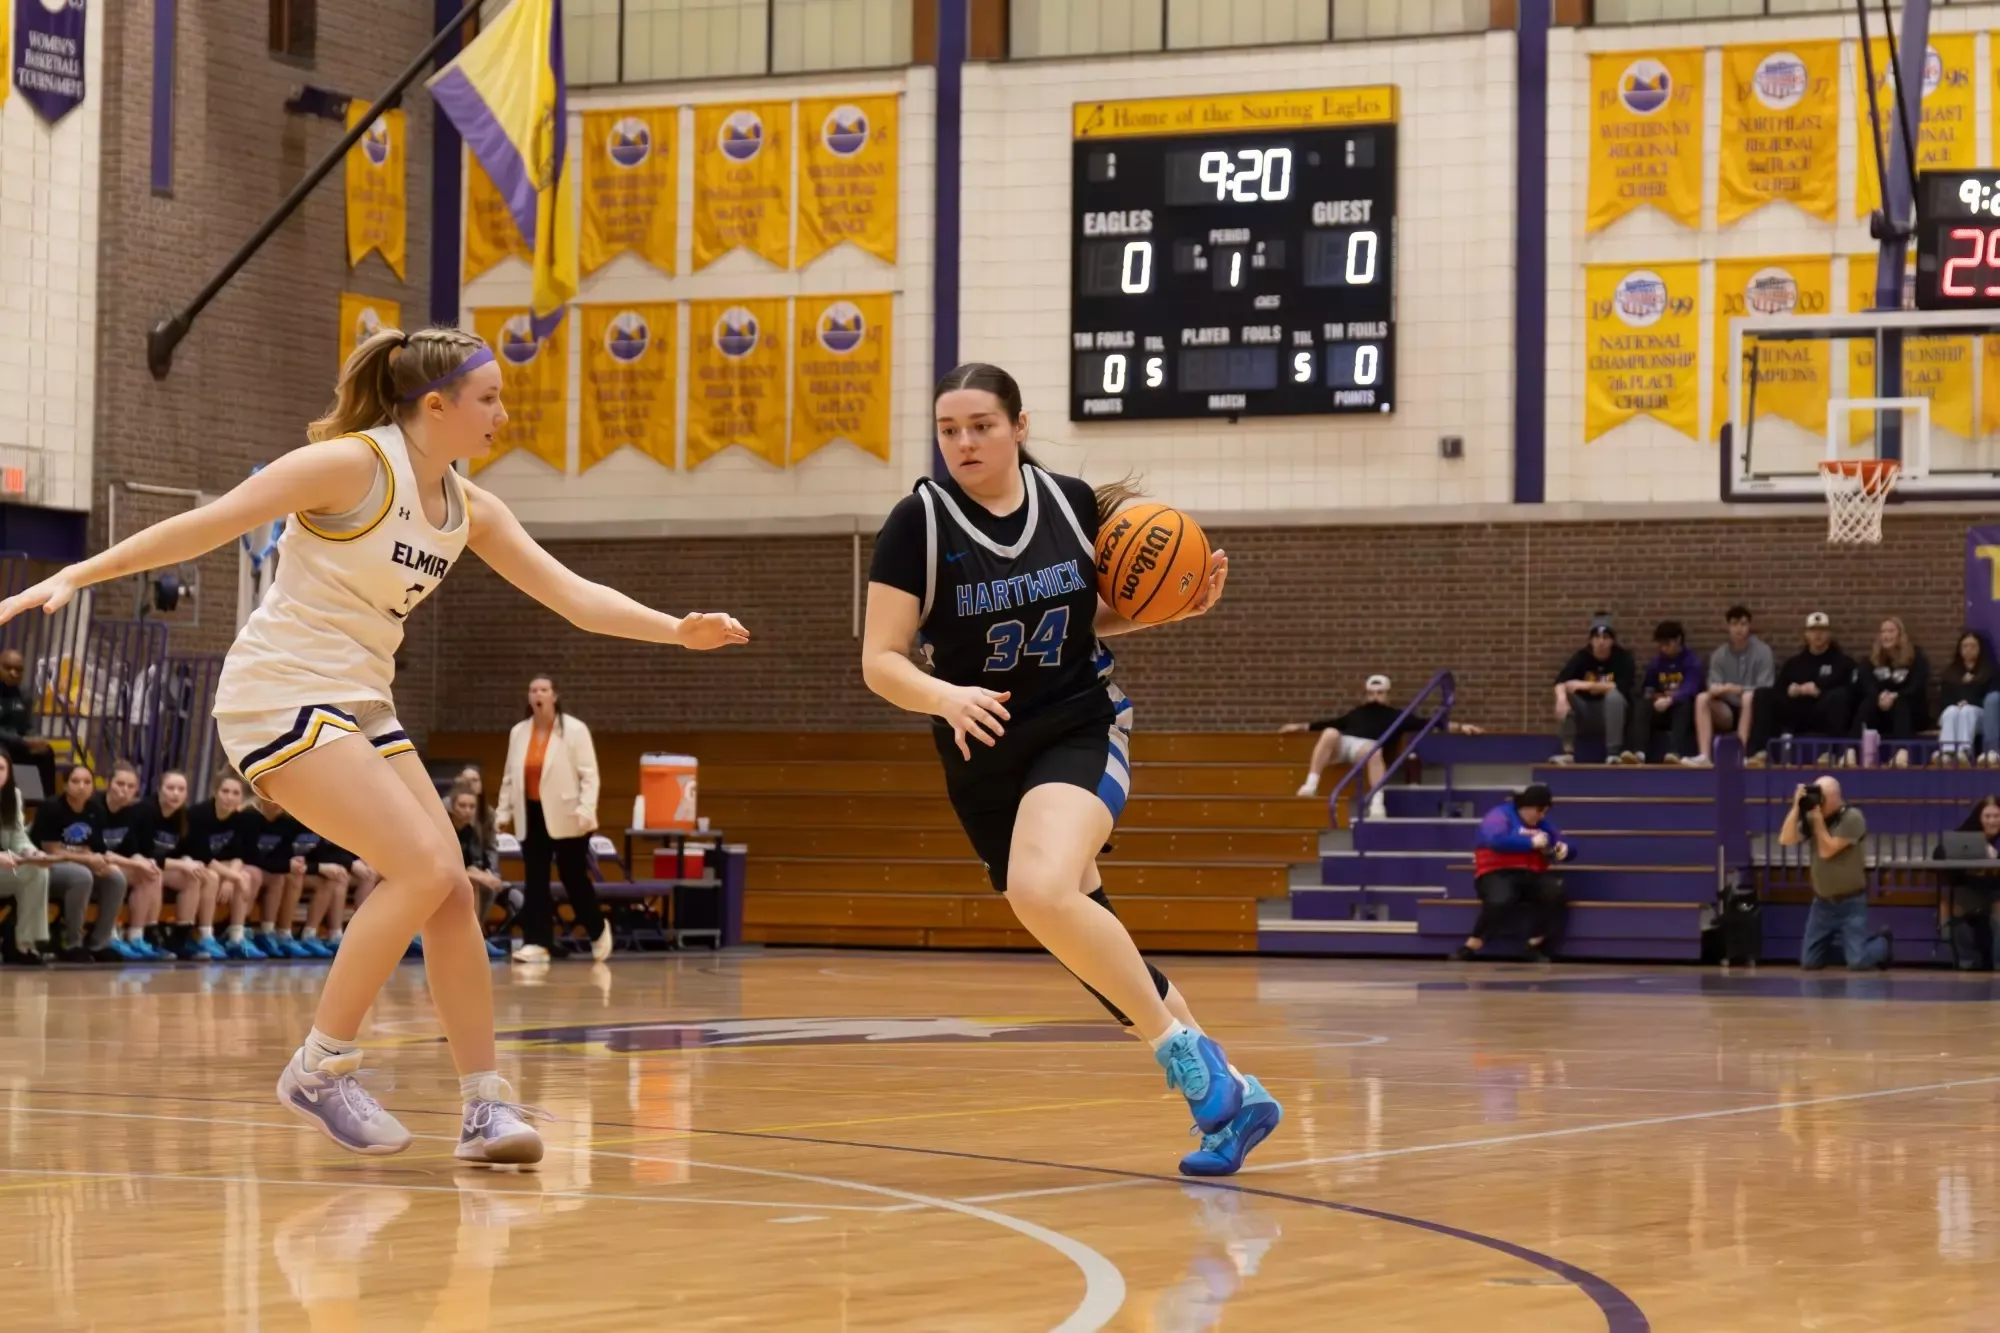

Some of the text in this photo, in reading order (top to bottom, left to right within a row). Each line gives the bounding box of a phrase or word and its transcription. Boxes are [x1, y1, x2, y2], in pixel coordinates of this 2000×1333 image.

[1113, 94, 1381, 128] Home of the Soaring Eagles
[1199, 147, 1292, 202] 9:20
[1083, 209, 1154, 237] EAGLES
[1312, 199, 1373, 226] GUEST
[1209, 227, 1251, 246] PERIOD
[1121, 241, 1153, 294] 0
[1230, 251, 1242, 288] 1
[1345, 231, 1378, 285] 0
[1096, 330, 1135, 348] FOULS
[1181, 325, 1282, 346] PLAYER FOULS
[1324, 321, 1388, 341] TM FOULS
[1600, 333, 1685, 351] NATIONAL
[1103, 354, 1126, 393] 0
[1354, 345, 1379, 385] 0
[1208, 393, 1246, 411] MATCH
[1333, 389, 1375, 408] POINTS
[391, 540, 456, 579] ELMIR
[1119, 525, 1173, 601] Wilson
[956, 559, 1087, 617] HARTWICK
[982, 605, 1070, 672] 34
